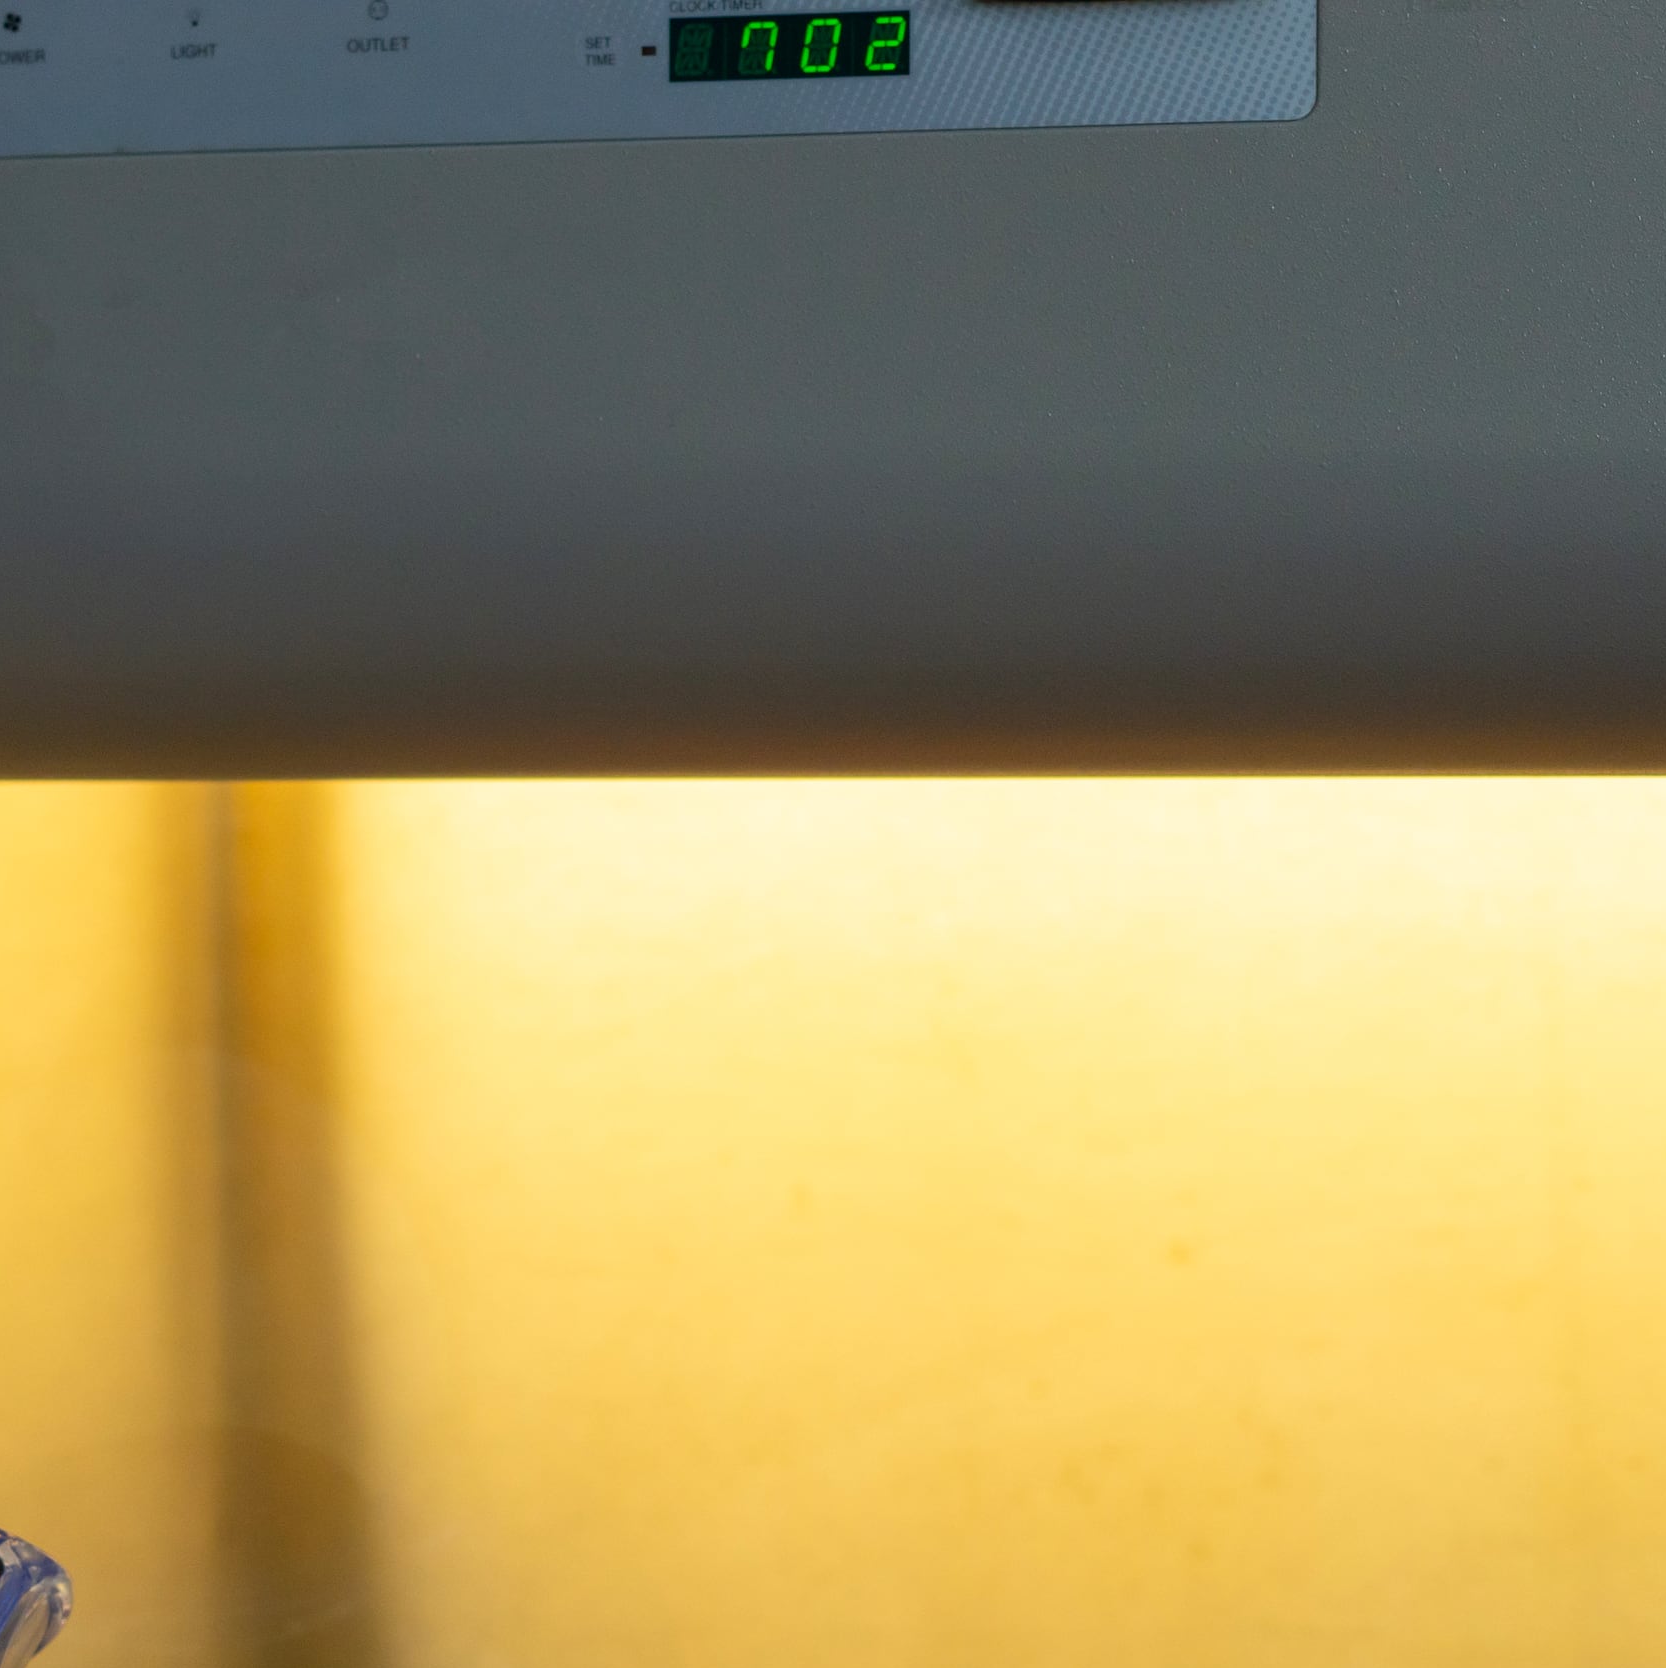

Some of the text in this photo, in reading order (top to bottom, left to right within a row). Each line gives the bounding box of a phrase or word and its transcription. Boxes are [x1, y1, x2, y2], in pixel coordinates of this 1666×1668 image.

[346, 36, 411, 54] OUTLET
[585, 36, 612, 49] SET
[741, 16, 907, 73] 702
[170, 43, 217, 60] LIGHT
[586, 53, 616, 66] TIME
